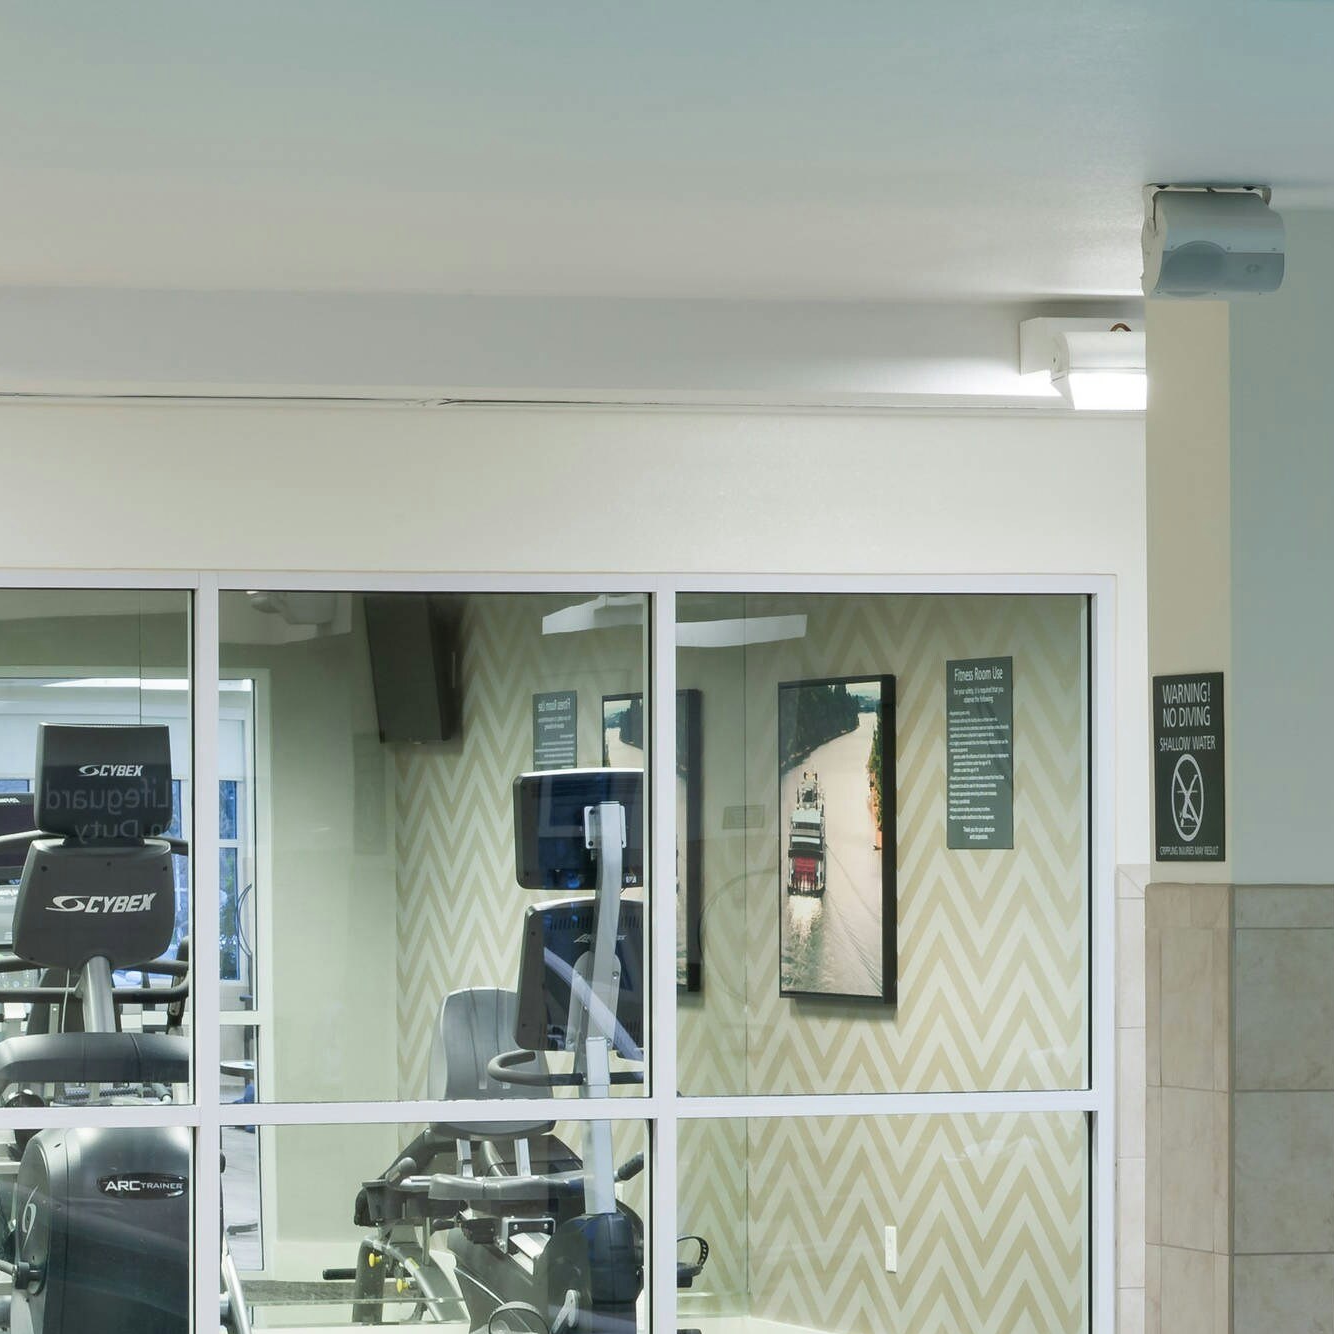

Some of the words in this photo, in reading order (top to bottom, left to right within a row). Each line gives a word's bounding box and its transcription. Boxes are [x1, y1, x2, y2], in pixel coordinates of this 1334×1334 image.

[974, 667, 992, 681] Room
[992, 665, 1003, 680] Use
[1162, 681, 1210, 704] WARNING!
[1163, 707, 1177, 728] NO
[1179, 705, 1210, 727] DIVING
[1160, 736, 1191, 751] SHALLOW
[1192, 735, 1216, 751] WATER
[99, 764, 144, 777] CYBEX
[84, 892, 157, 914] CYBEX
